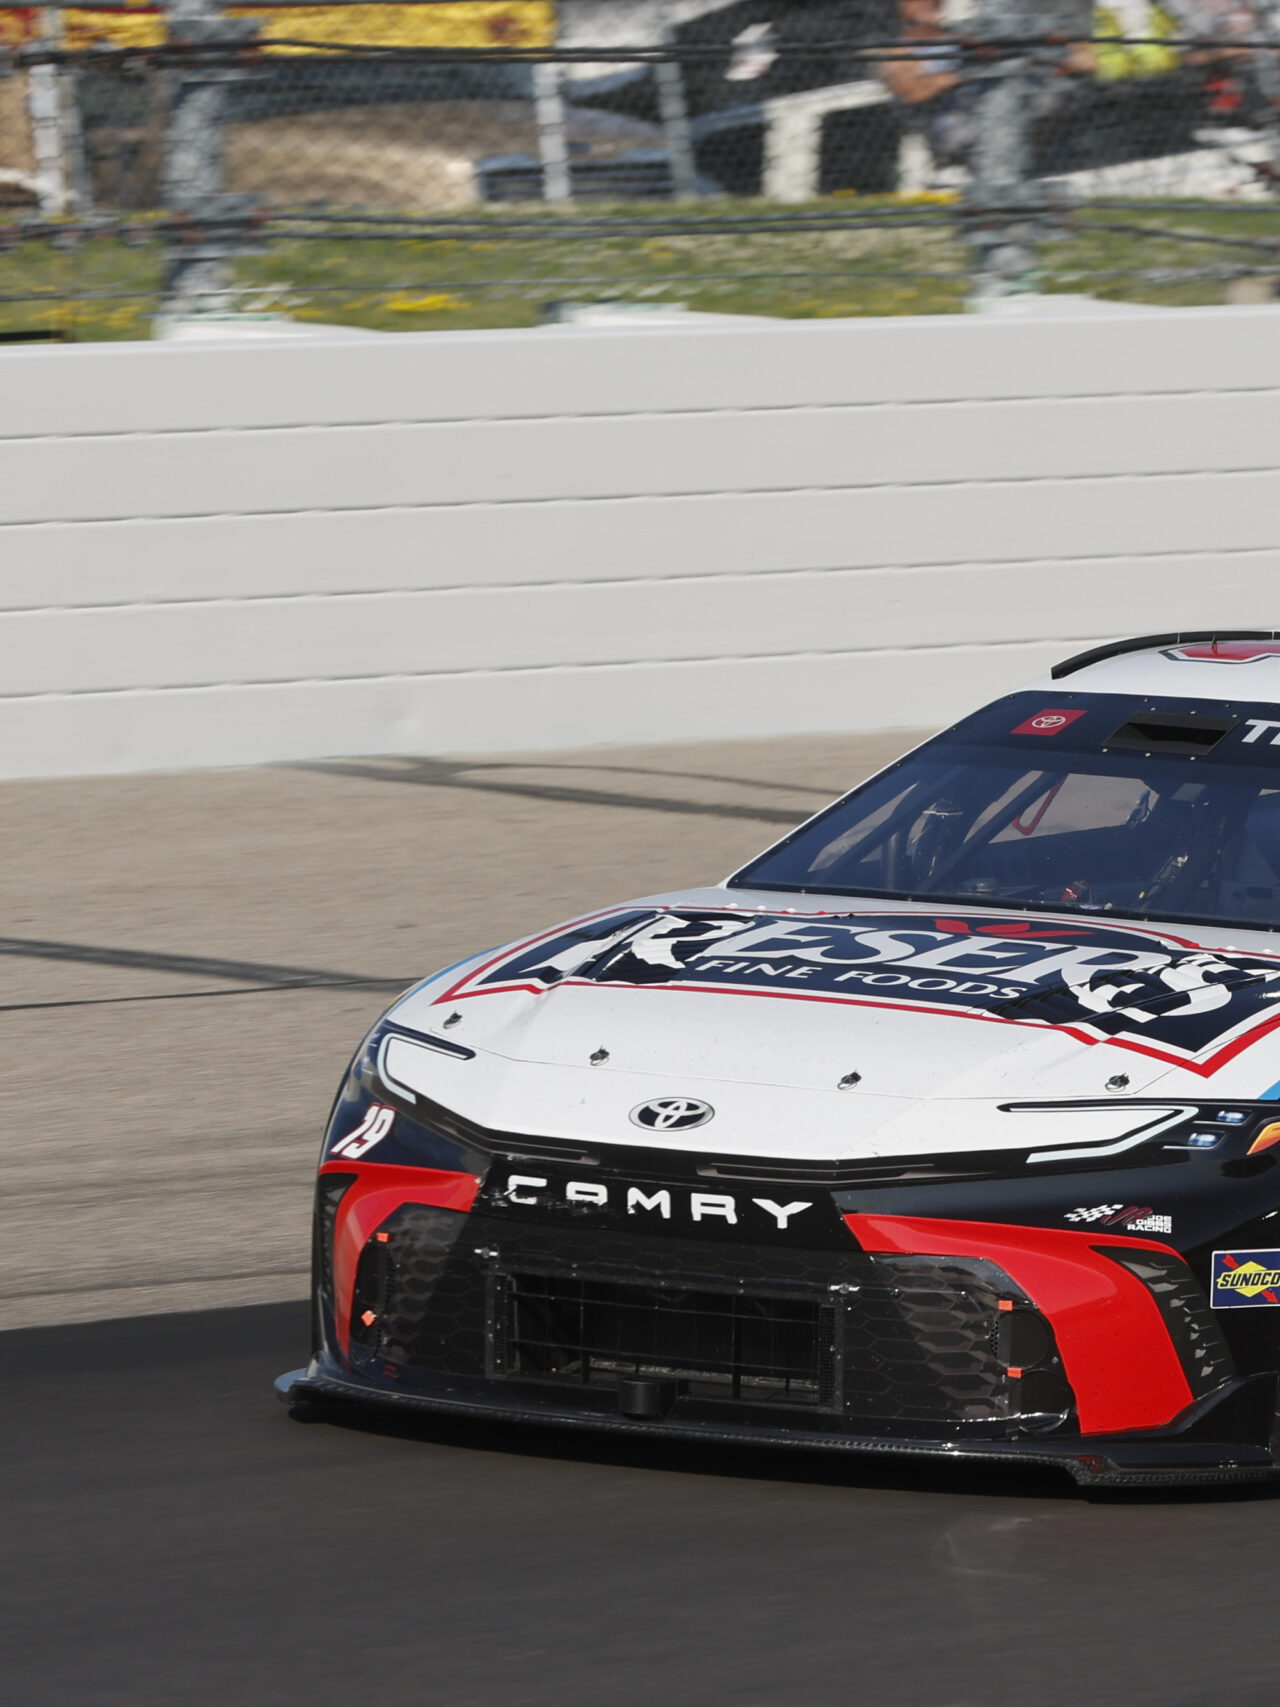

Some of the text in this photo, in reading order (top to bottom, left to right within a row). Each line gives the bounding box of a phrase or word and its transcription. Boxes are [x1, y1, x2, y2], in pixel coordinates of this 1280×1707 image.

[694, 959, 1028, 999] FINE FOODS
[329, 1104, 396, 1159] 19
[505, 1174, 813, 1230] CAMRY
[1127, 1223, 1172, 1234] RACING
[1135, 1218, 1172, 1228] GIBBS
[1147, 1214, 1172, 1222] JOE
